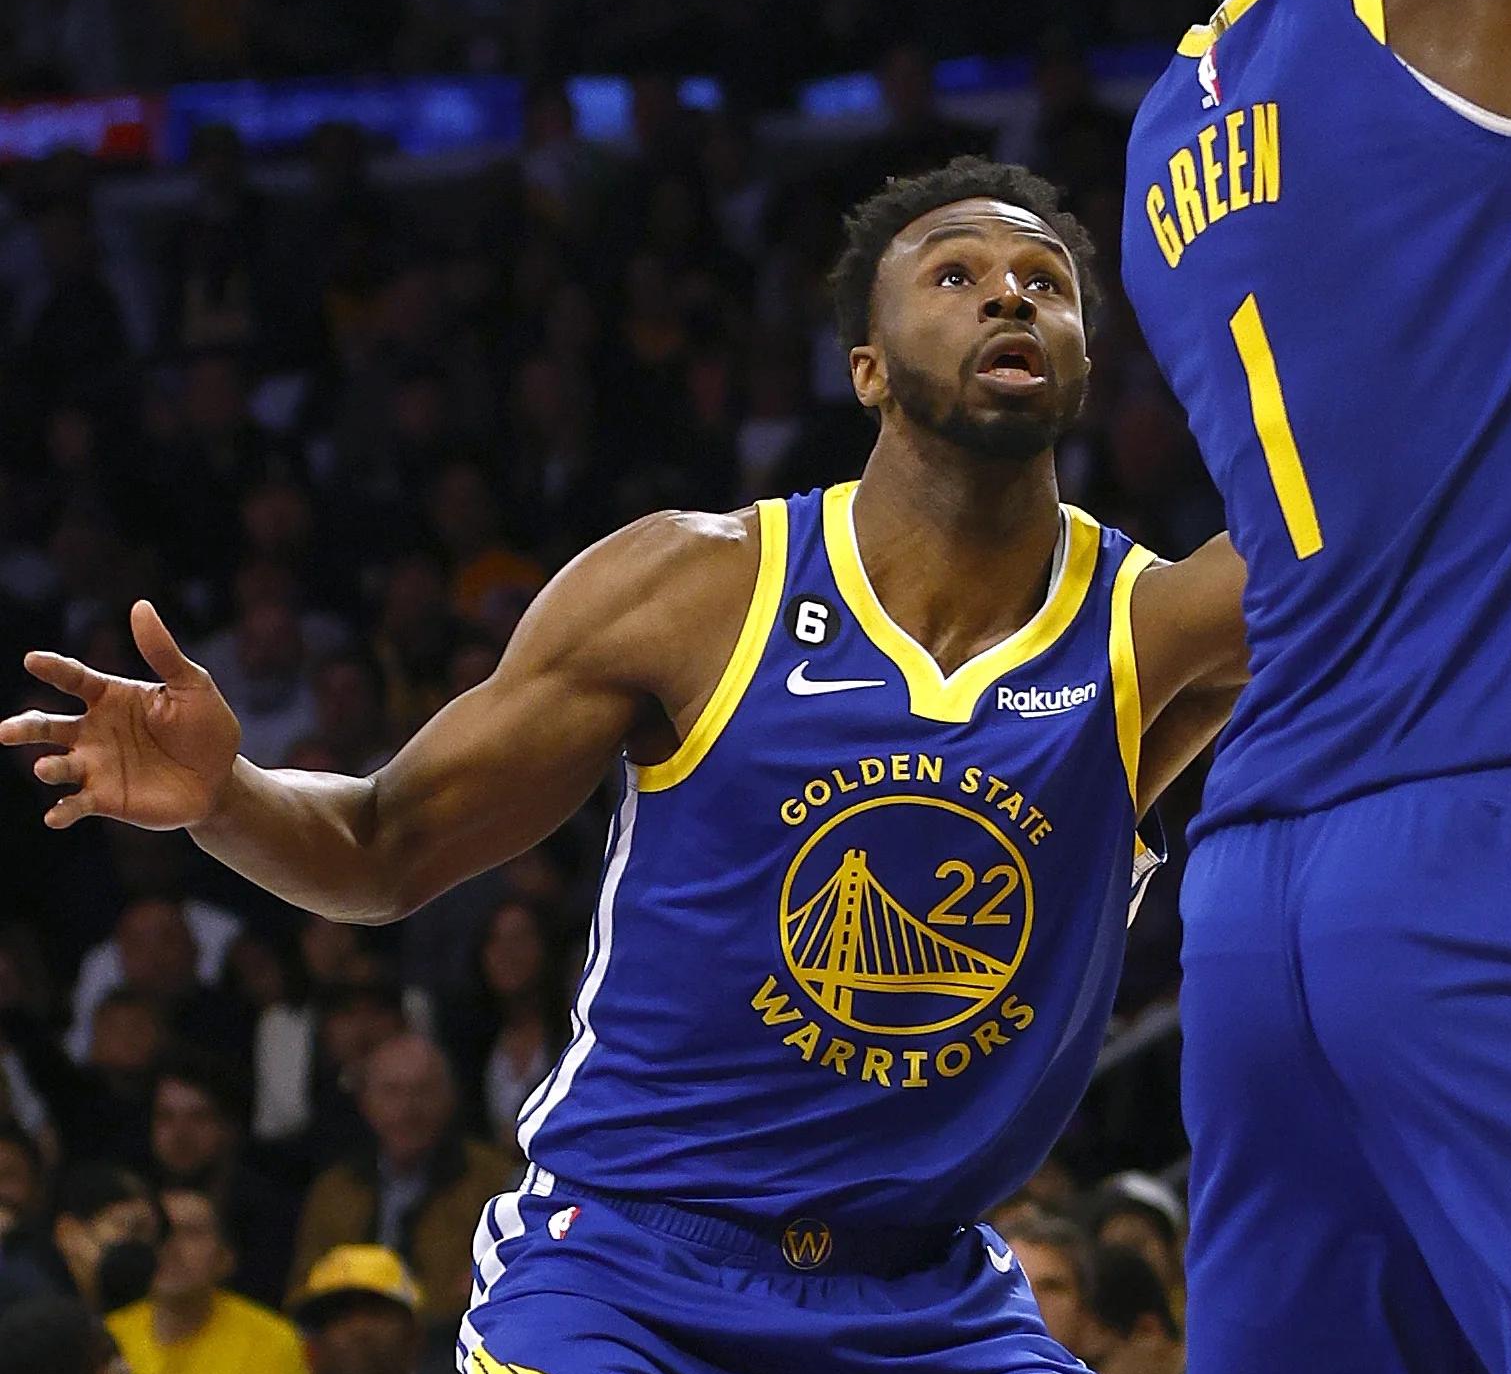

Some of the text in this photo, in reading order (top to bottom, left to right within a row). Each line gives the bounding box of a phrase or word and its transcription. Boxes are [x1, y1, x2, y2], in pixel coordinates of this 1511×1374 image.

[1145, 101, 1281, 270] GREEN
[1228, 291, 1325, 561] 1
[794, 601, 828, 644] 6
[997, 682, 1097, 712] Rakuten
[780, 753, 1054, 847] GOLDEN STATE
[926, 860, 1020, 927] 22
[750, 974, 1036, 1089] WARRIORS
